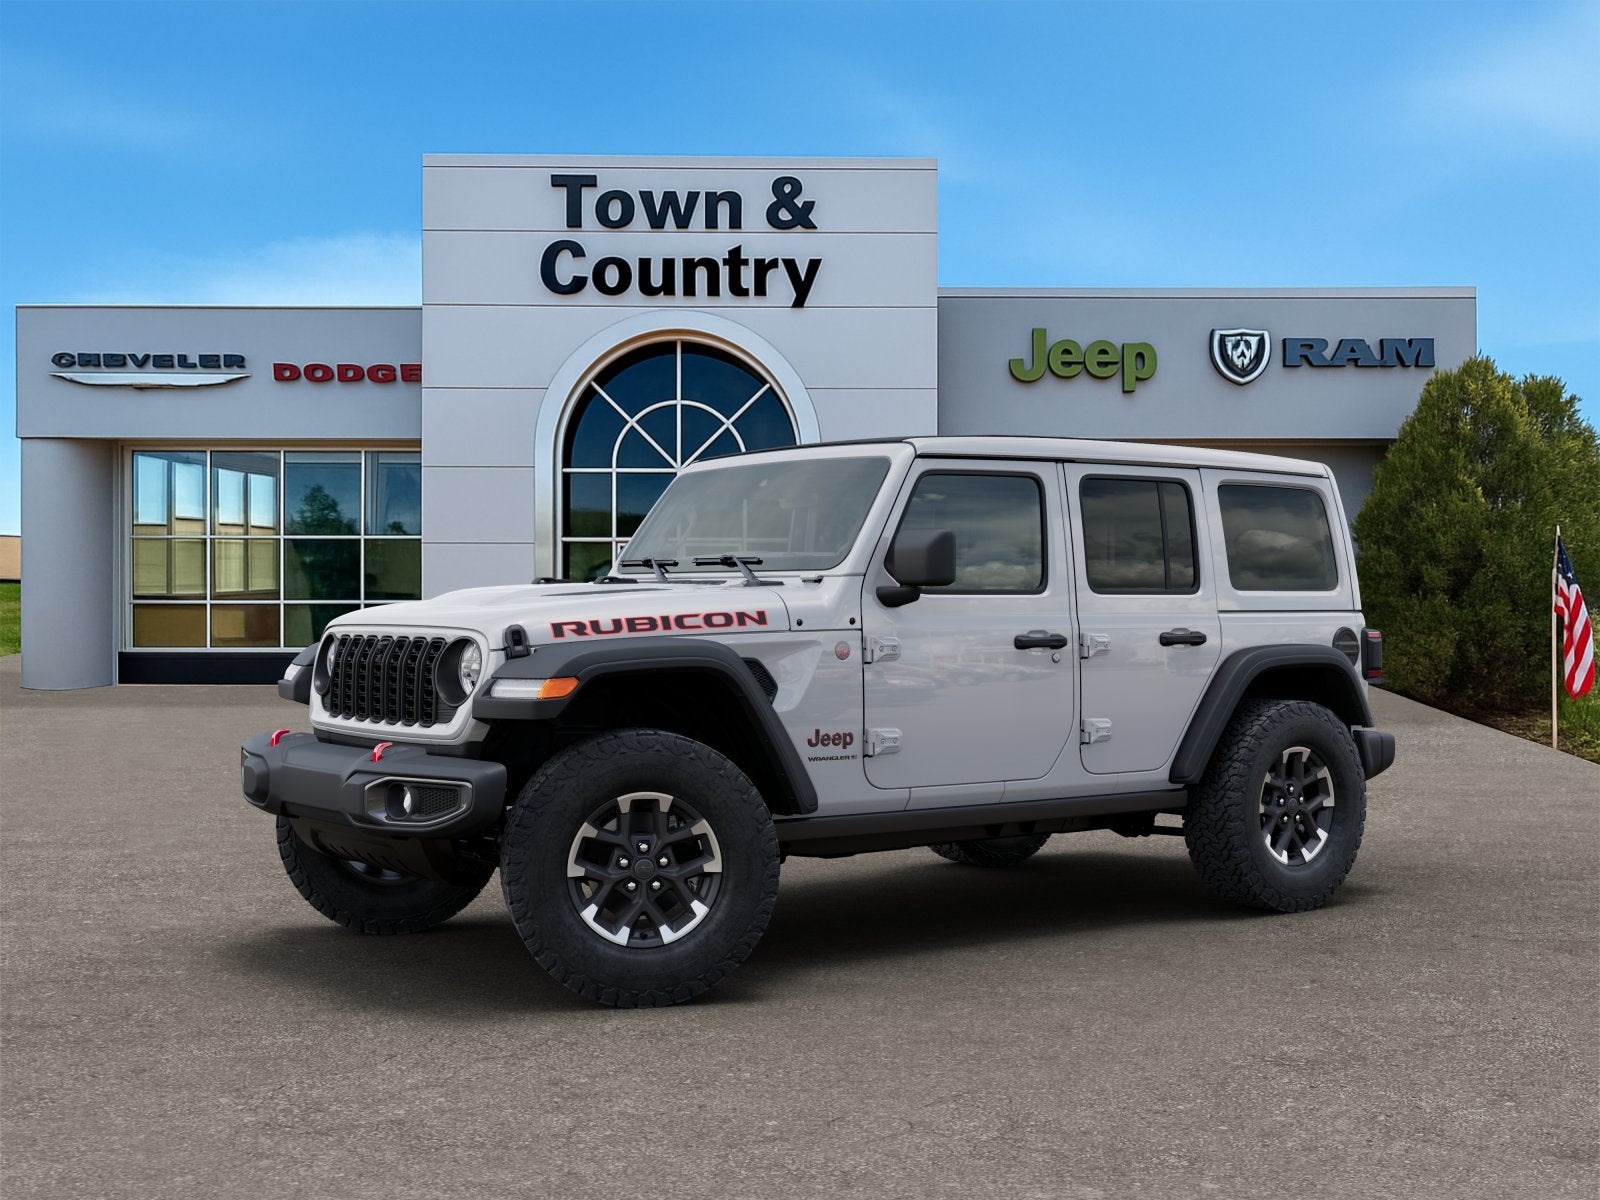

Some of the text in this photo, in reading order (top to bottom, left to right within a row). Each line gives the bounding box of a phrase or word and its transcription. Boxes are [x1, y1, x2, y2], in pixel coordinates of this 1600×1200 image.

[551, 174, 817, 229] Town &
[540, 240, 822, 308] Country
[1009, 328, 1157, 392] Jeep
[1282, 337, 1436, 368] RAM
[273, 363, 422, 383] DODGE
[550, 610, 768, 639] RUBICON
[807, 729, 853, 749] Jeep
